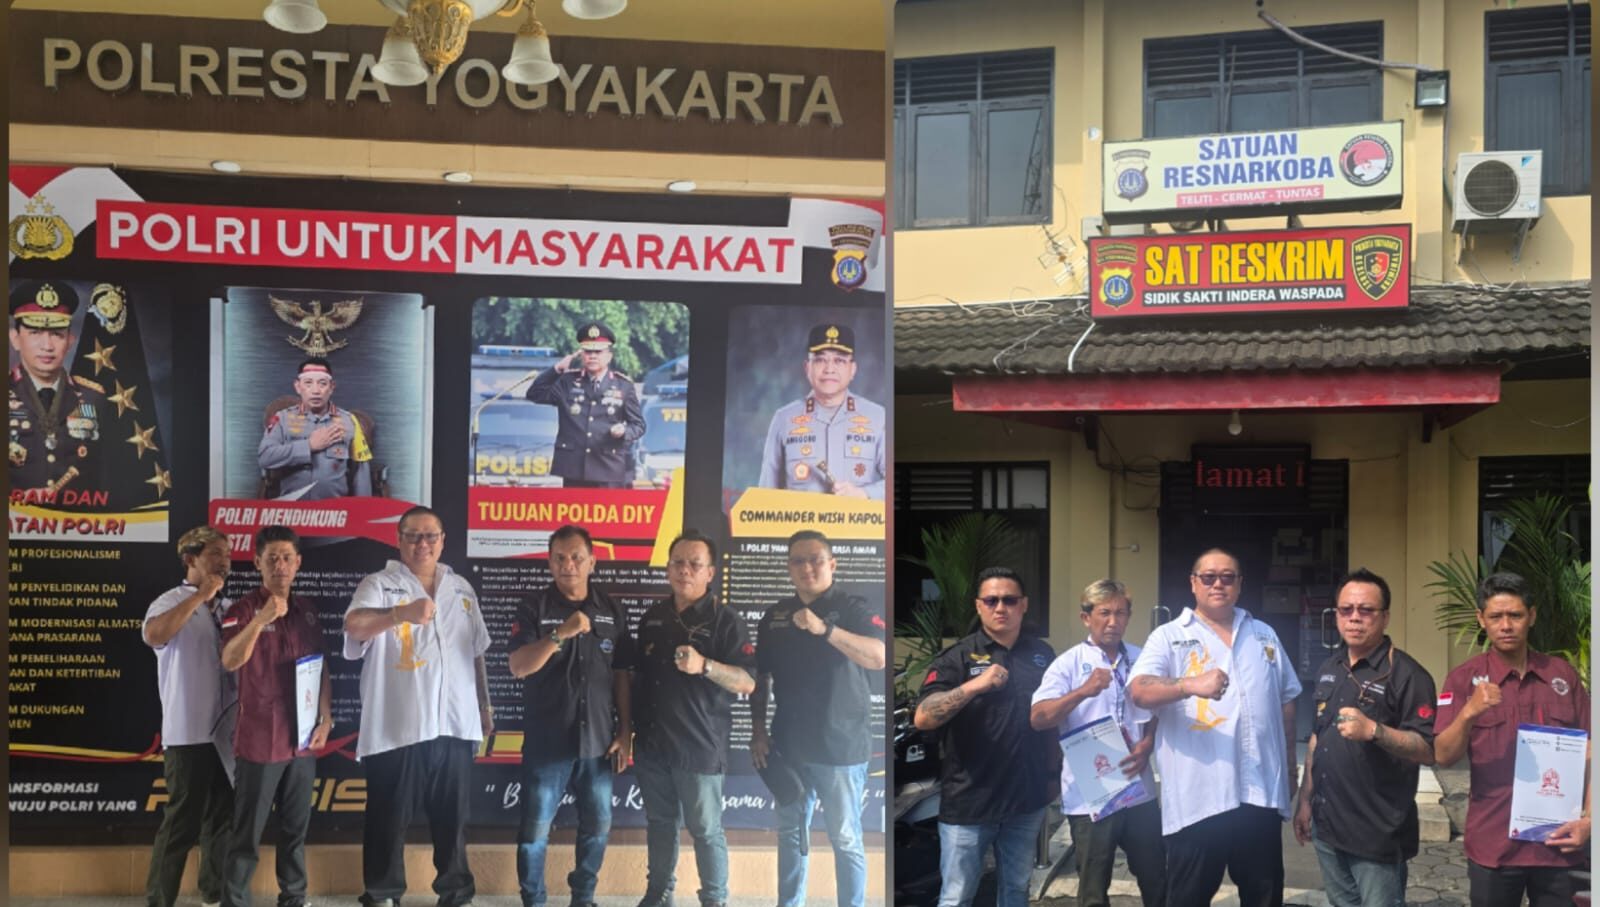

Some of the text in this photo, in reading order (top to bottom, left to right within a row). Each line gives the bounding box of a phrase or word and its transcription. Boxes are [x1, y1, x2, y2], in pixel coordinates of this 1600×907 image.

[43, 37, 392, 103] POLRESTA
[1199, 133, 1298, 160] SATUAN
[1164, 157, 1335, 188] RESNARKOBA
[1222, 191, 1266, 203] CERMAT
[1275, 188, 1320, 199] TUNTAS
[109, 211, 260, 256] POLRI
[277, 219, 452, 266] UNTUK
[464, 228, 795, 273] MASYARAKAT
[1145, 245, 1202, 285] SAT
[1211, 239, 1344, 284] RESKRIM
[1144, 286, 1344, 305] SIDIK SAKTI INDERA WASPADA
[63, 490, 109, 507] DAN
[215, 507, 348, 528] POLRI MENDUKUNG
[478, 502, 655, 524] TUJUAN POLDA DIY
[740, 510, 815, 523] COMMANDER
[818, 511, 844, 523] WISH
[61, 518, 126, 536] POLRI
[21, 549, 120, 559] PROFESIONALISME
[21, 583, 99, 592] PENYELIDIKAN
[102, 584, 126, 593] DAN
[33, 598, 74, 607] TINDAK
[76, 598, 118, 607] PIDANA
[21, 619, 95, 628] MODERNISASI
[37, 633, 102, 642] PRASARANA
[21, 655, 105, 663] PEMELIHARAAN
[29, 669, 53, 677] DAN
[56, 669, 120, 678] KETERTIBAN
[21, 705, 85, 714] DUKUNGAN
[48, 801, 94, 811] POLRI
[97, 800, 137, 811] YANG
